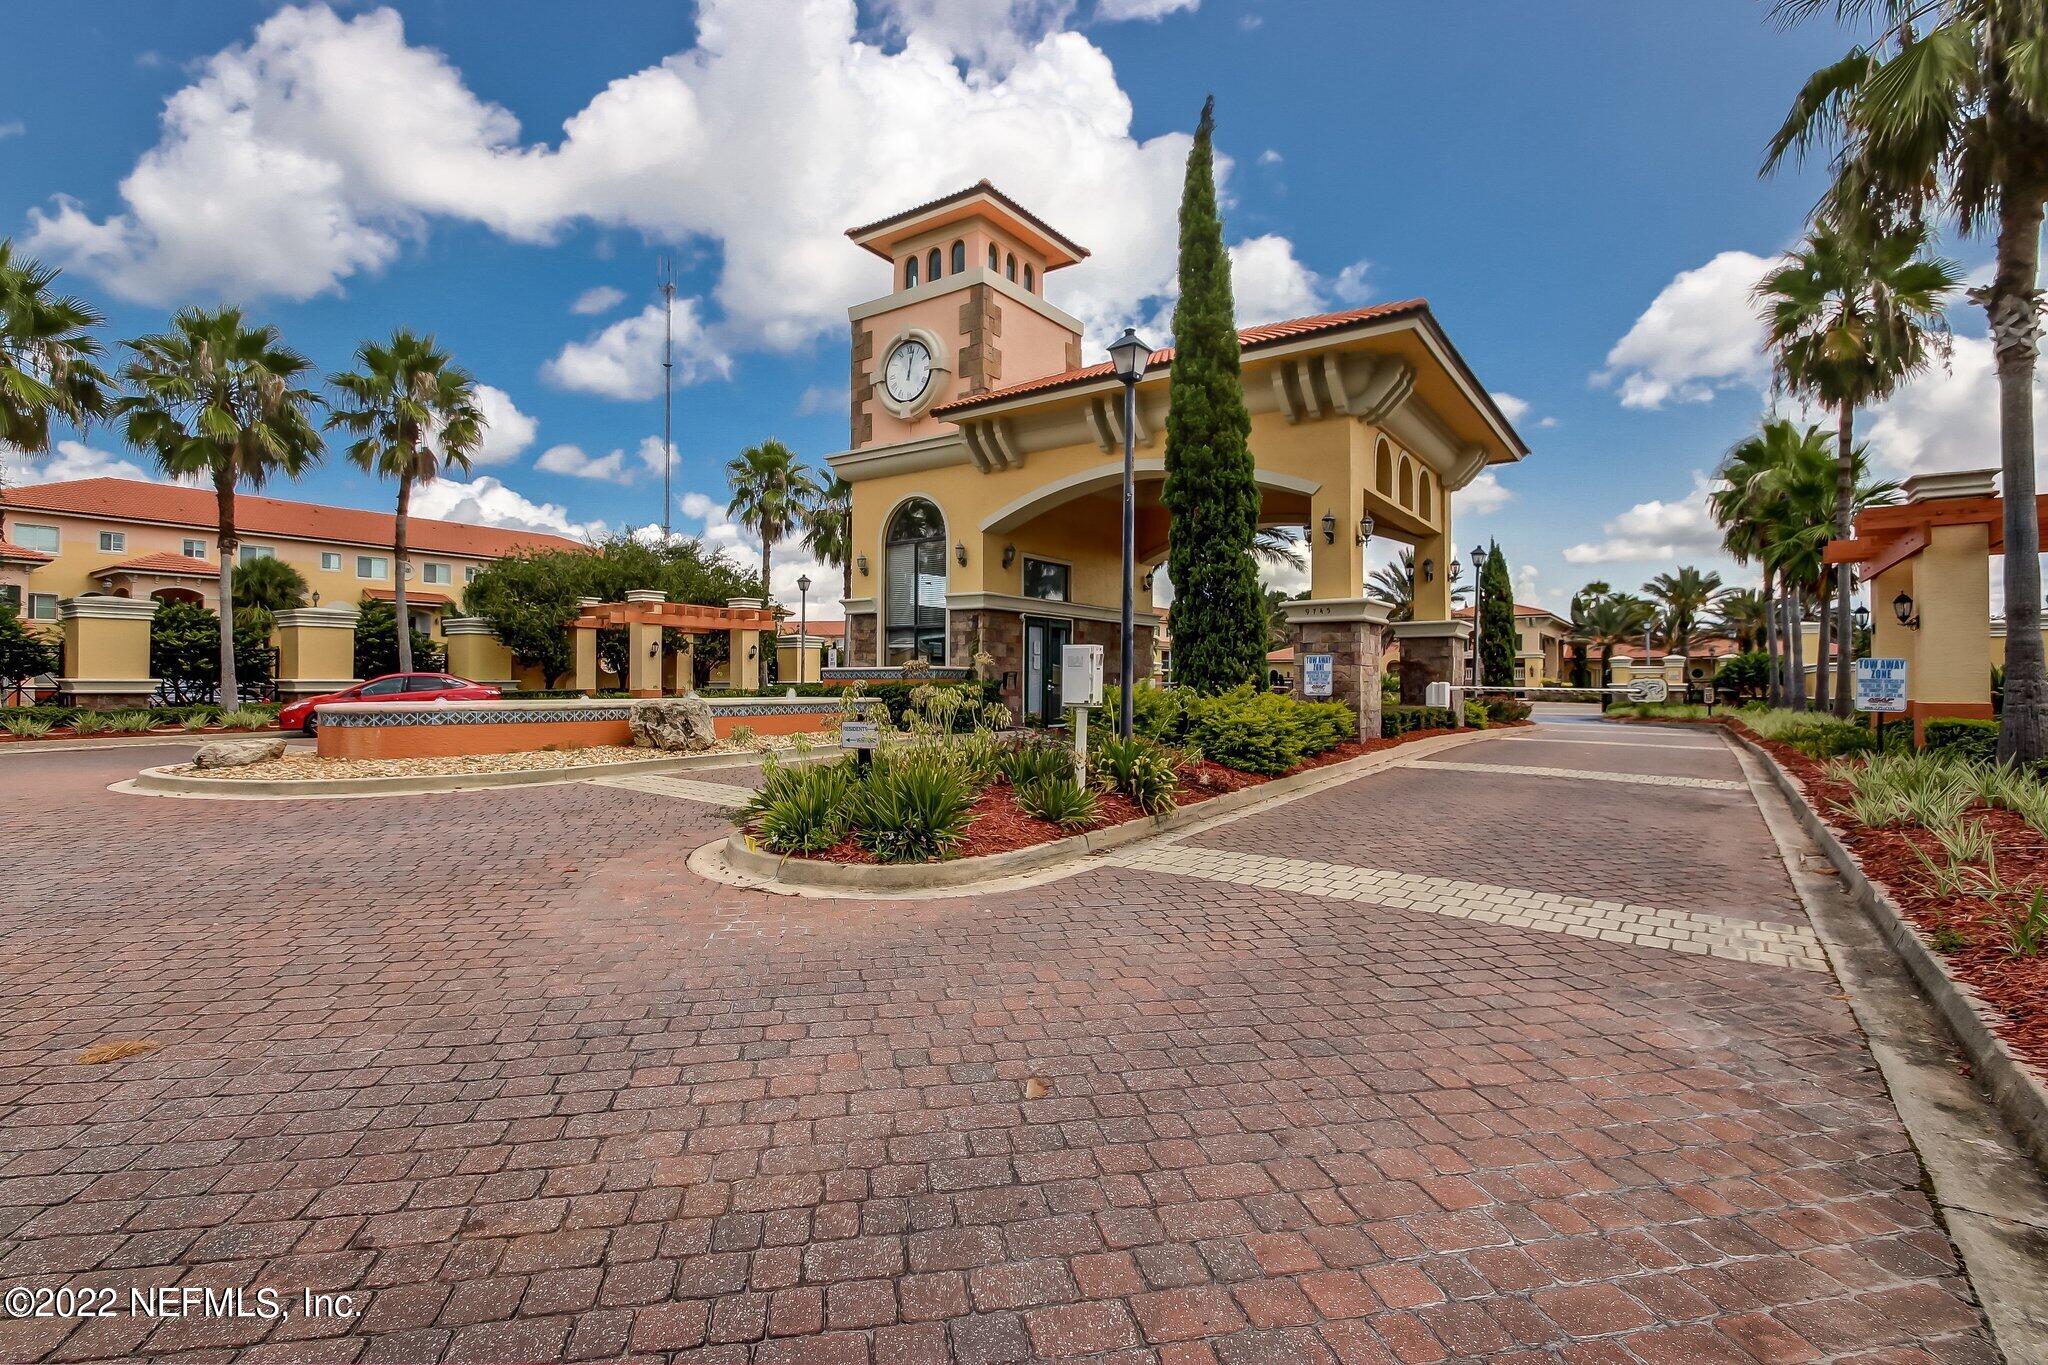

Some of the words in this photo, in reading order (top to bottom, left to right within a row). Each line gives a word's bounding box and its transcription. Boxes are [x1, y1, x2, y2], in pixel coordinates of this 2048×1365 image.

[1306, 656, 1317, 664] TOW
[1318, 656, 1331, 664] AWAY
[1859, 659, 1878, 669] TOW
[1880, 659, 1905, 669] AWAY
[1871, 669, 1892, 679] ZONE
